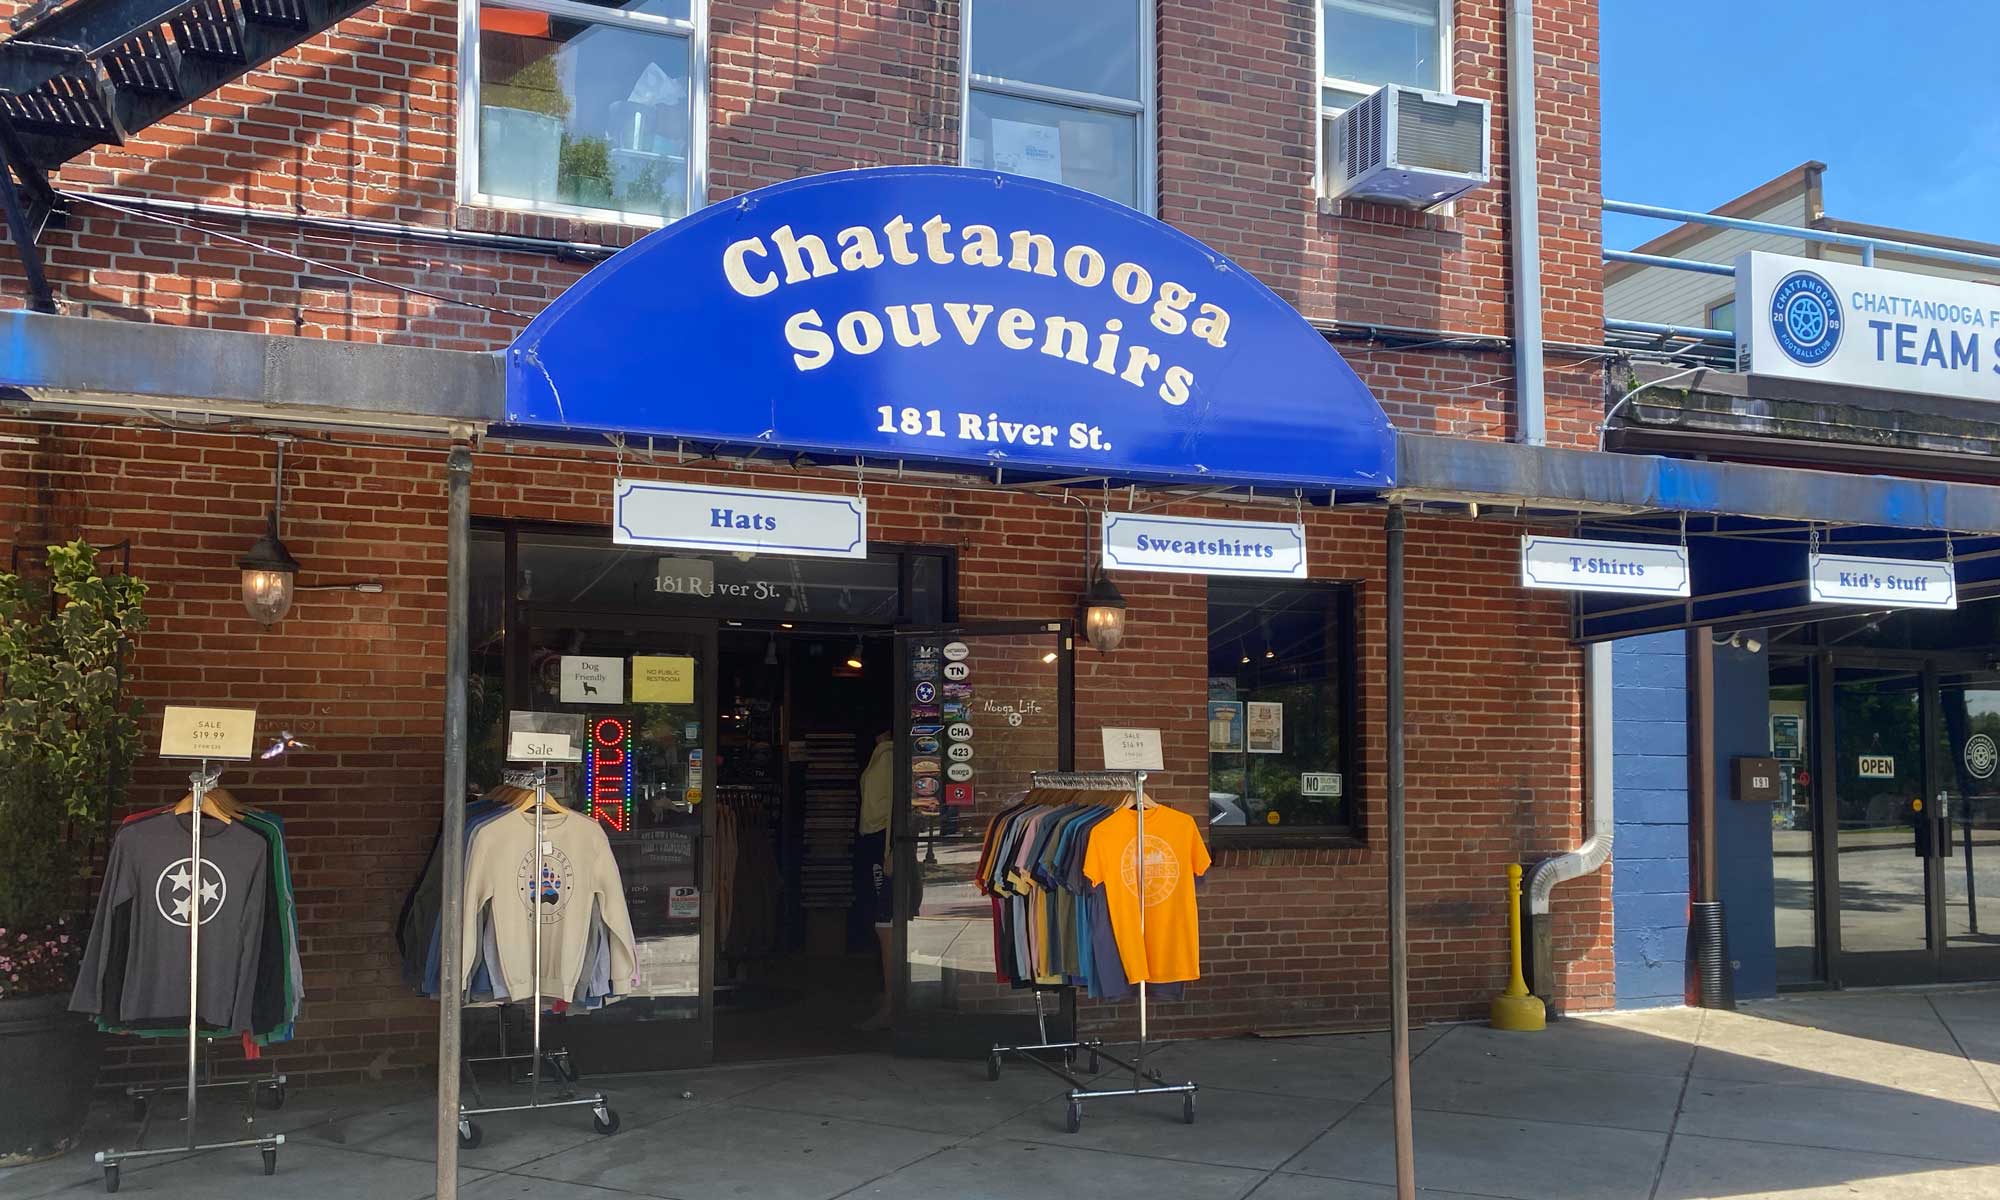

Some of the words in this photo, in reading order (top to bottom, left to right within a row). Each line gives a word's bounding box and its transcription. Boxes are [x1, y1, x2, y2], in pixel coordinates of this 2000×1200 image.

[723, 214, 1231, 348] Chattanooga
[1777, 279, 1836, 317] CHATTANOOGA
[1773, 312, 1784, 323] 20
[1852, 291, 1985, 327] CHATTANOOGA
[1829, 319, 1840, 329] 09
[1782, 333, 1815, 357] FOOTBALL
[1868, 319, 1979, 373] TEAM
[784, 303, 1194, 406] Souvenirs
[877, 405, 946, 438] 181
[958, 412, 1059, 448] River
[1069, 422, 1112, 451] St.
[710, 508, 777, 531] Hats
[1136, 534, 1274, 560] Sweatshirts
[1570, 556, 1645, 577] T-Shirts
[654, 576, 683, 594] 181
[754, 581, 780, 600] St.
[1839, 571, 1881, 590] Kid's
[1886, 575, 1929, 592] Stuff
[581, 662, 600, 672] Dog
[949, 667, 965, 676] TN
[575, 672, 606, 682] Friendly
[984, 699, 1014, 716] Nooga
[1019, 700, 1042, 715] Life
[198, 721, 222, 729] SALE
[951, 728, 970, 737] CHA
[192, 731, 225, 740] $19.99
[527, 743, 553, 756] Sale
[952, 748, 969, 757] 423
[595, 718, 624, 832] OPEN
[1861, 759, 1893, 774] OPEN
[1306, 777, 1319, 792] NO
[1755, 777, 1768, 787] 191
